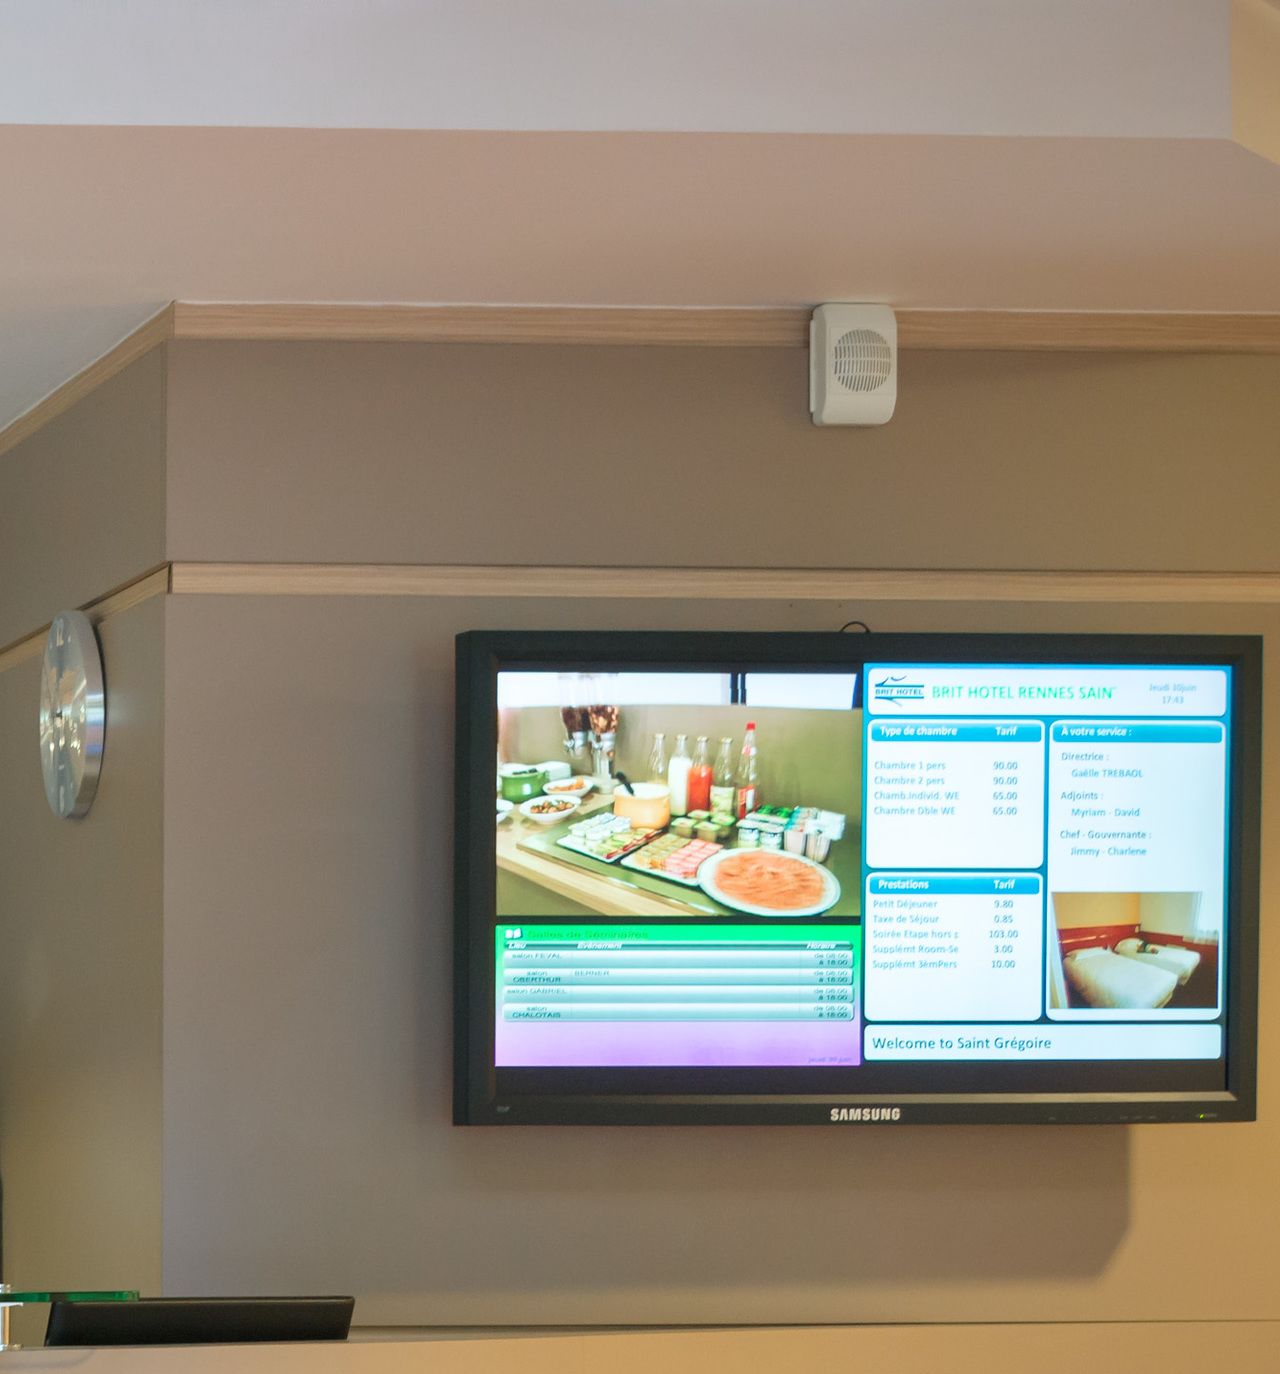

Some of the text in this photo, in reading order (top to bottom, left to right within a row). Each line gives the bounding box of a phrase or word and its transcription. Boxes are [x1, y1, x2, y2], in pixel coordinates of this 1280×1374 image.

[932, 686, 1117, 700] BRIT HOTEL RENNES SAIN
[880, 726, 958, 737] Type de chambre
[995, 726, 1017, 736] Tarif
[1070, 728, 1095, 736] votre
[1096, 727, 1127, 736] service
[1061, 752, 1104, 761] Directrice
[874, 761, 916, 770] Chambre
[926, 763, 946, 772] pers
[993, 761, 1018, 770] 90.00
[874, 776, 916, 785] Chambre
[926, 778, 945, 787] pers
[993, 776, 1018, 785] 90.00
[945, 792, 960, 800] WE
[993, 791, 1017, 800] 65.00
[1060, 791, 1098, 801] Adjoints
[873, 806, 915, 815] Chambre
[942, 807, 956, 815] WE
[992, 806, 1017, 815] 65.00
[1071, 808, 1106, 818] Myriam
[1114, 808, 1140, 817] David
[1060, 830, 1080, 839] Chef
[1087, 830, 1147, 839] Gouvernante
[878, 879, 929, 889] Prestations
[993, 879, 1016, 889] Tarif
[873, 899, 938, 910] Petit Déjeuner
[873, 914, 939, 925] Taxe de Séjour
[992, 960, 1016, 969] 10.00
[872, 1036, 1052, 1051] Welcome to Saint Grégoire
[830, 1107, 901, 1121] SAMSUNG
